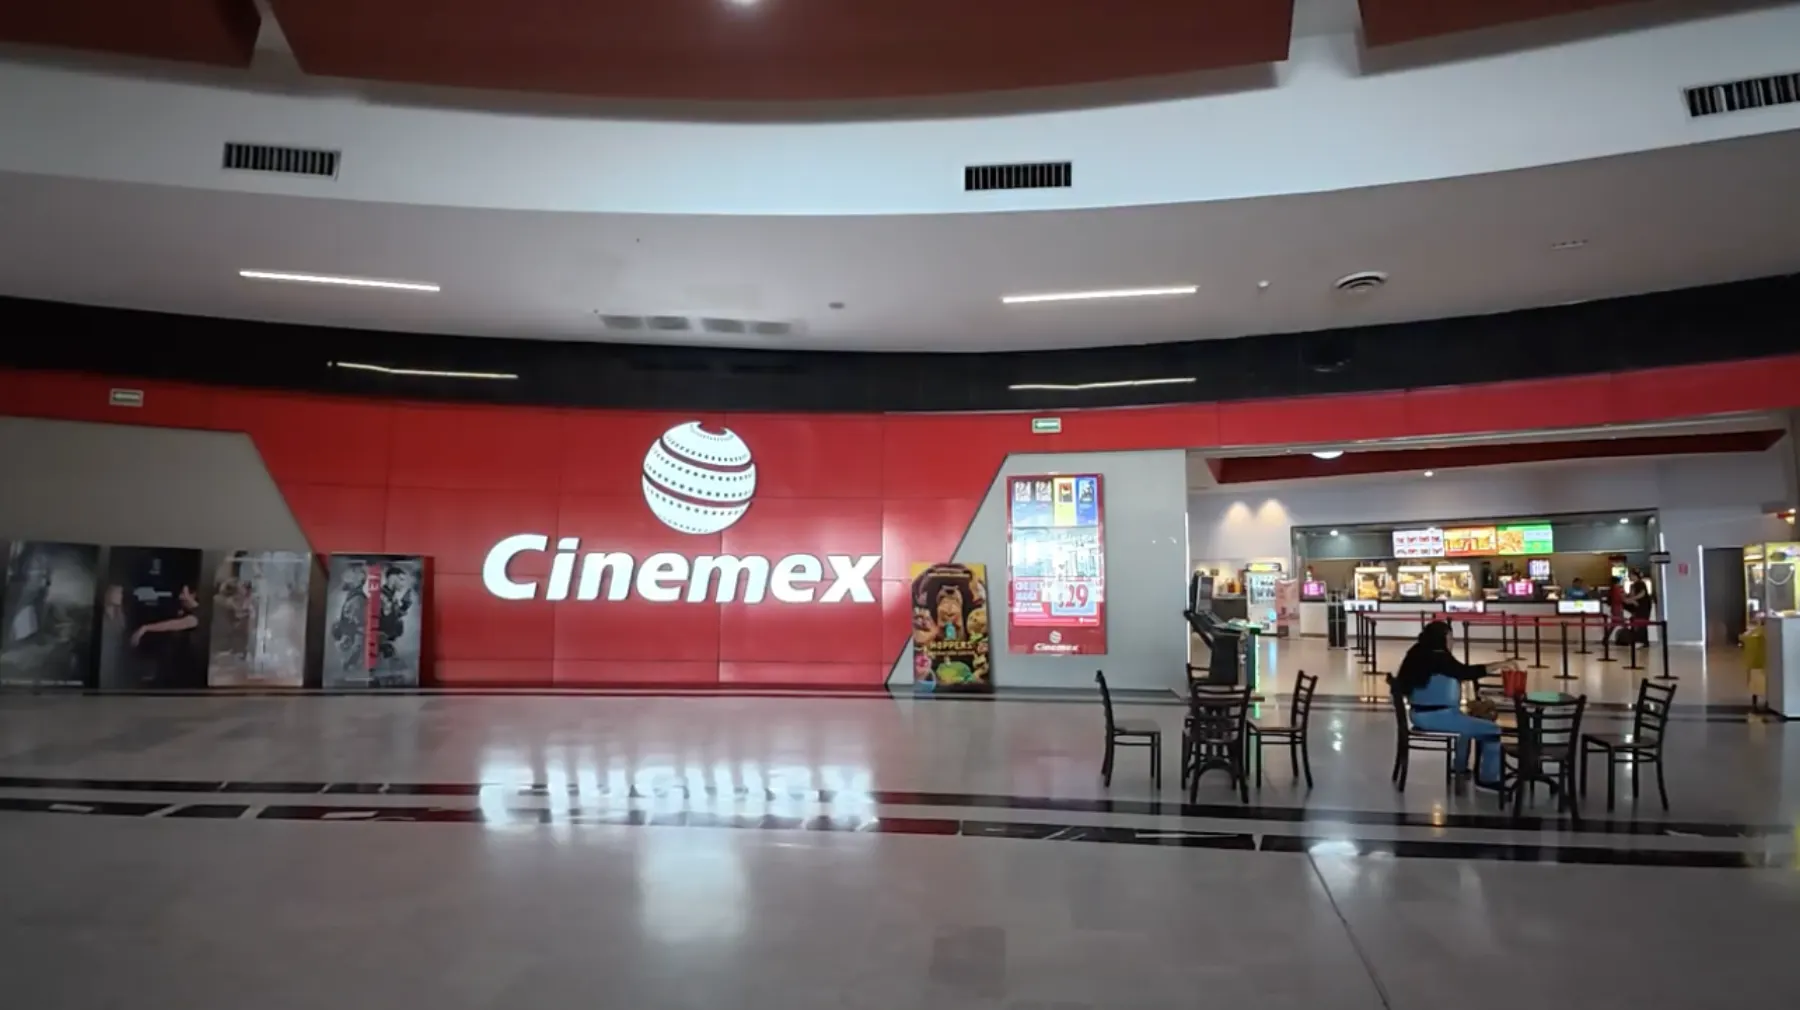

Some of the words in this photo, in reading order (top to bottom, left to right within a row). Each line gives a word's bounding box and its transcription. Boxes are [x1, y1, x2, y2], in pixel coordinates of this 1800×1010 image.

[482, 533, 881, 604] Cinemex
[929, 641, 973, 650] HOPPERS
[1034, 642, 1079, 651] Cinemex
